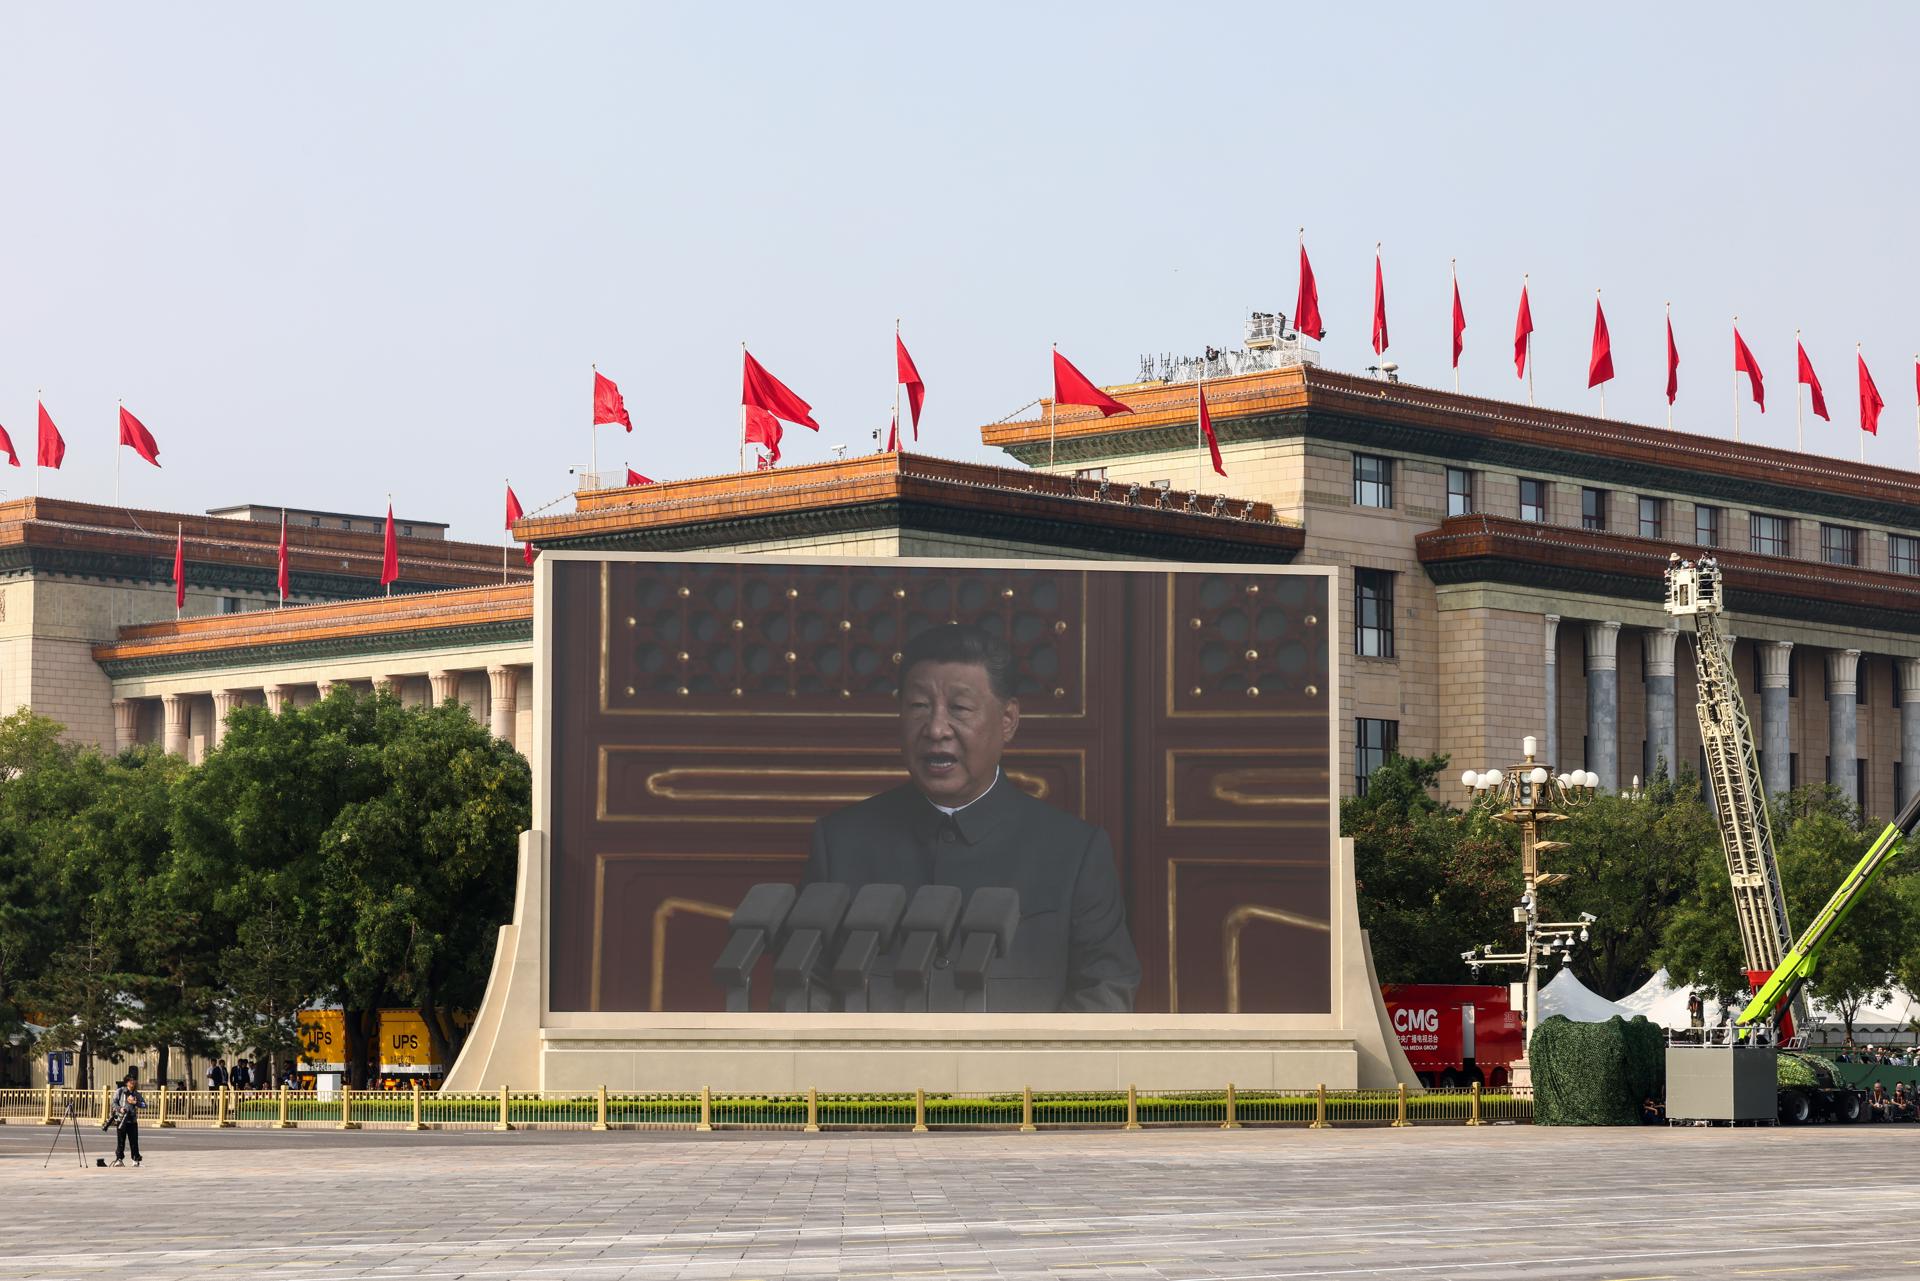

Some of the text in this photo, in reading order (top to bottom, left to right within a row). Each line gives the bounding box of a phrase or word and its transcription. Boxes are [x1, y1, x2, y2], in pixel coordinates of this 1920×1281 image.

[1394, 1008, 1439, 1032] CMG
[308, 1031, 332, 1045] UPS
[392, 1034, 418, 1049] UPS
